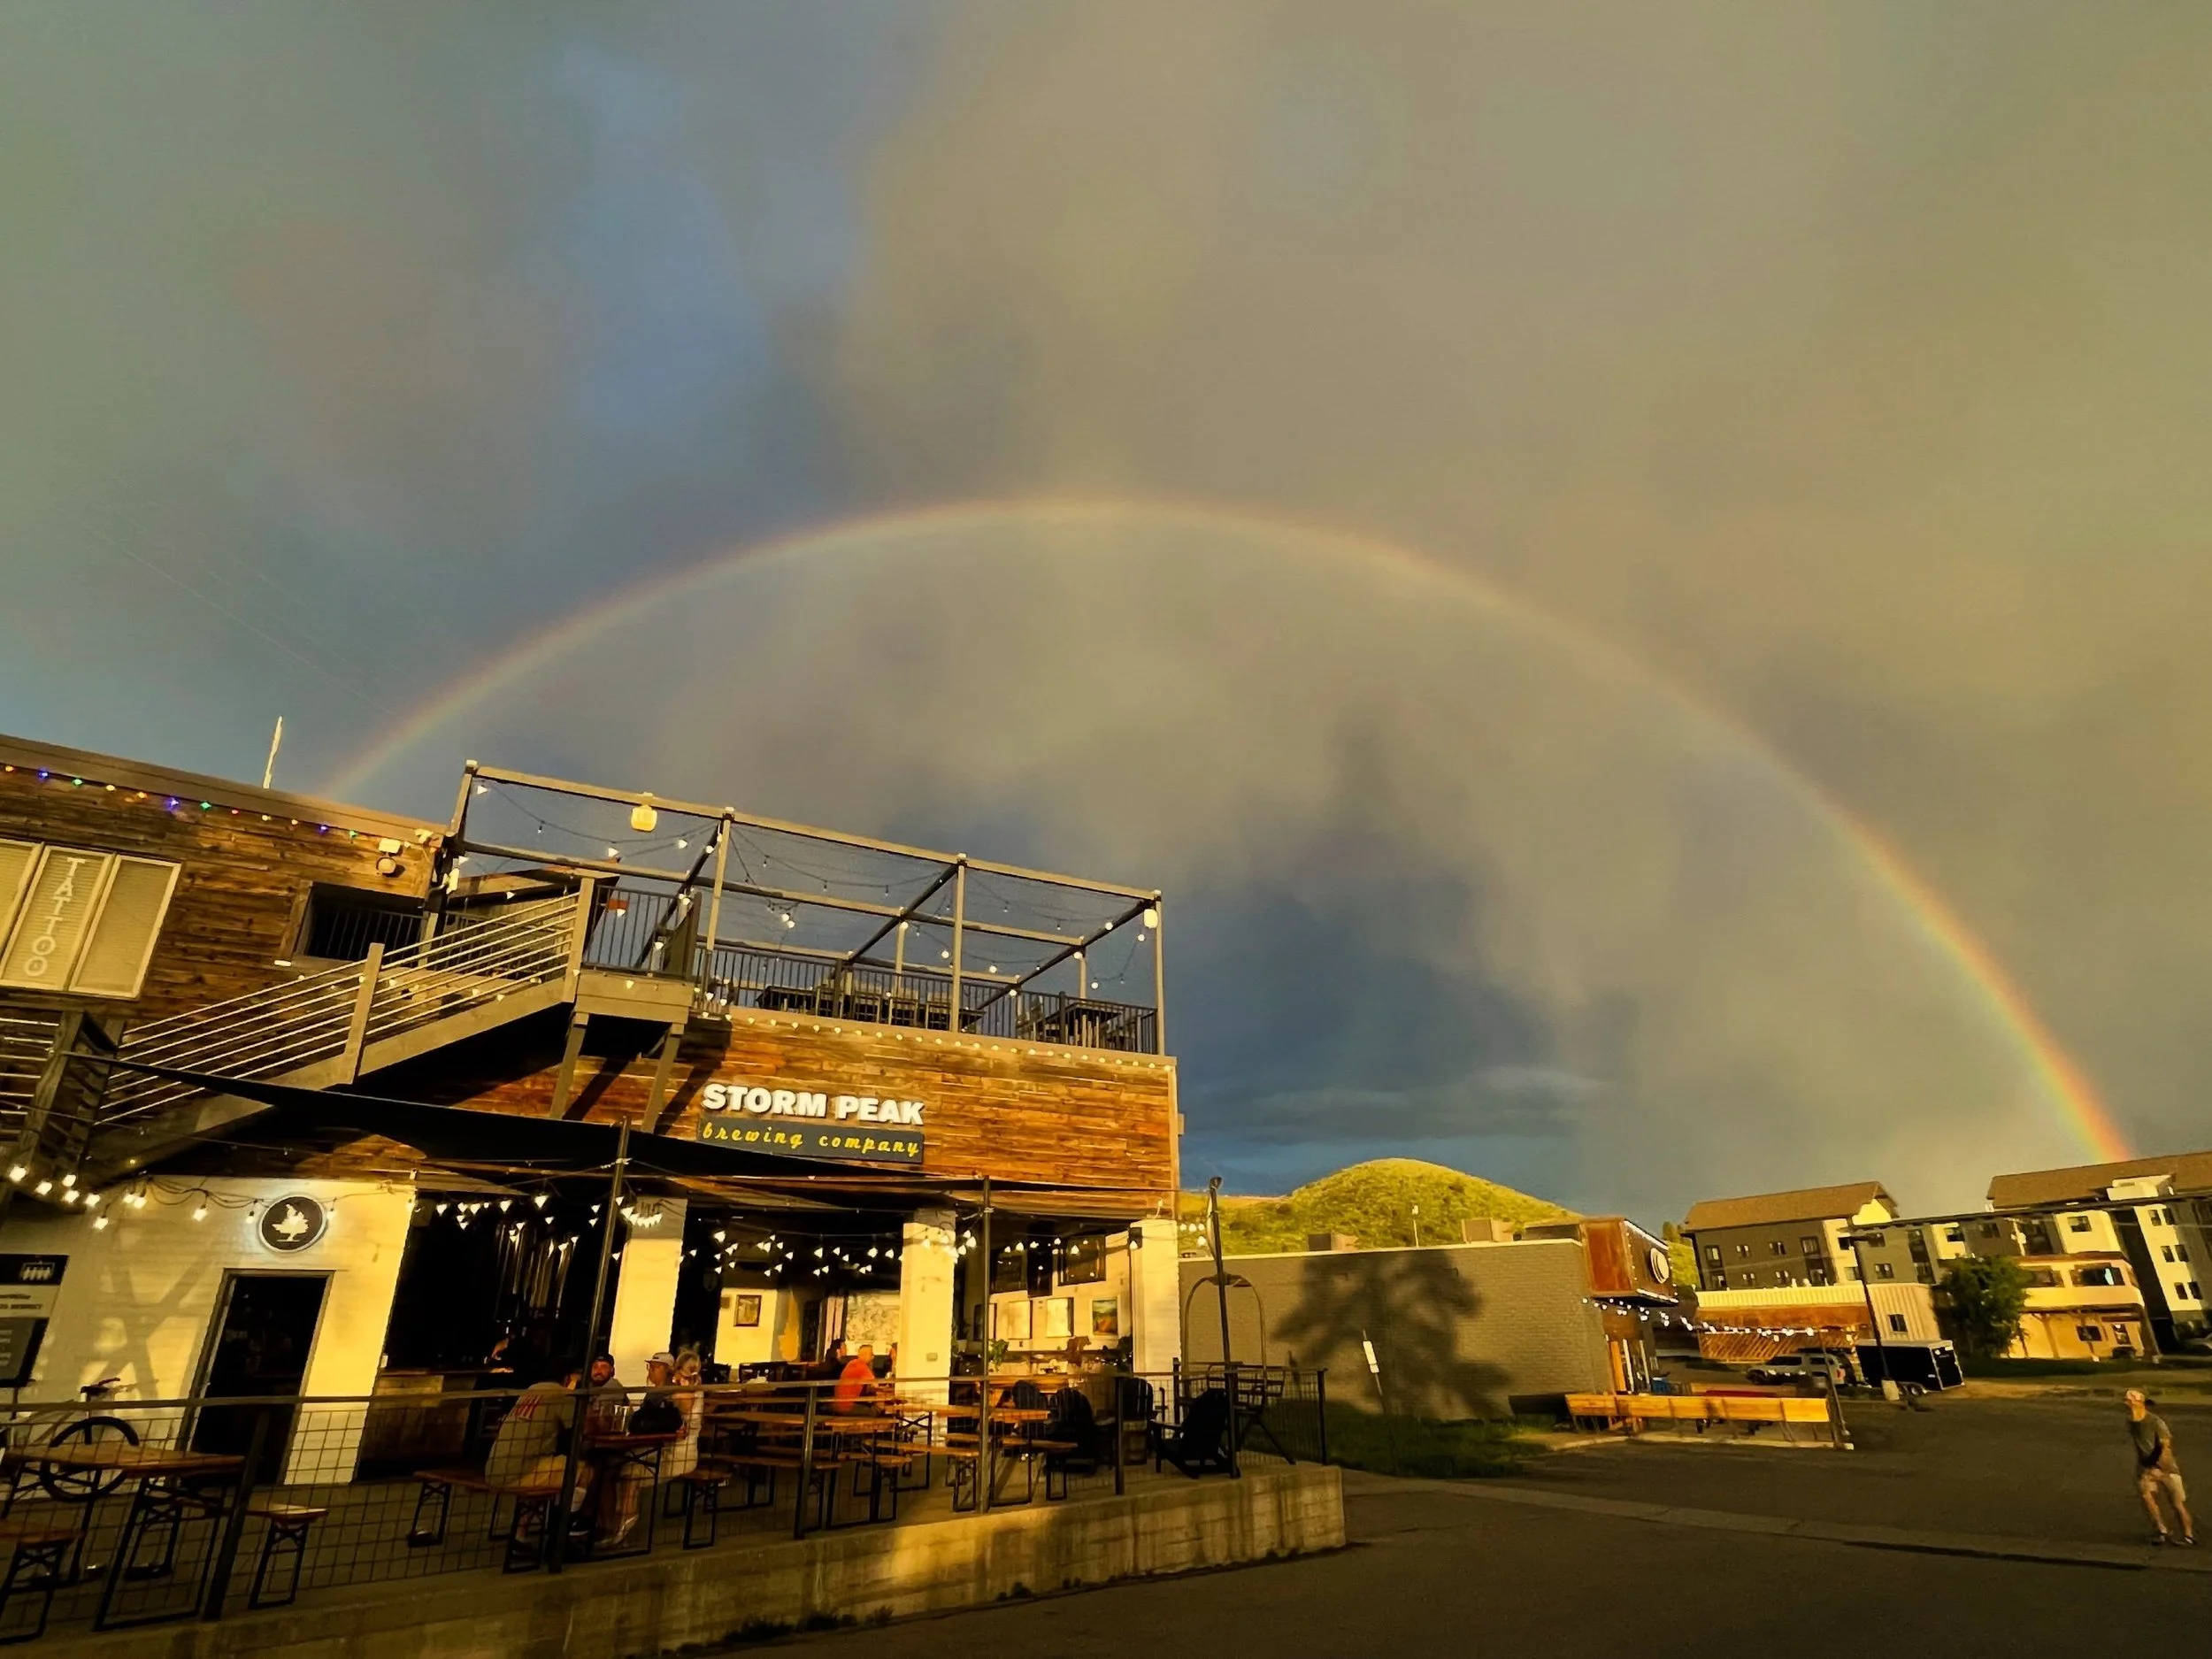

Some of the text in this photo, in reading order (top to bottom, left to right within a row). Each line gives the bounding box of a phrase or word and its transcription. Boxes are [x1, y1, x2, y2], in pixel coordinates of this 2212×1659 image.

[25, 856, 86, 977] TATTOO
[702, 1083, 925, 1125] STORM PEAK
[702, 1121, 919, 1157] brewing company
